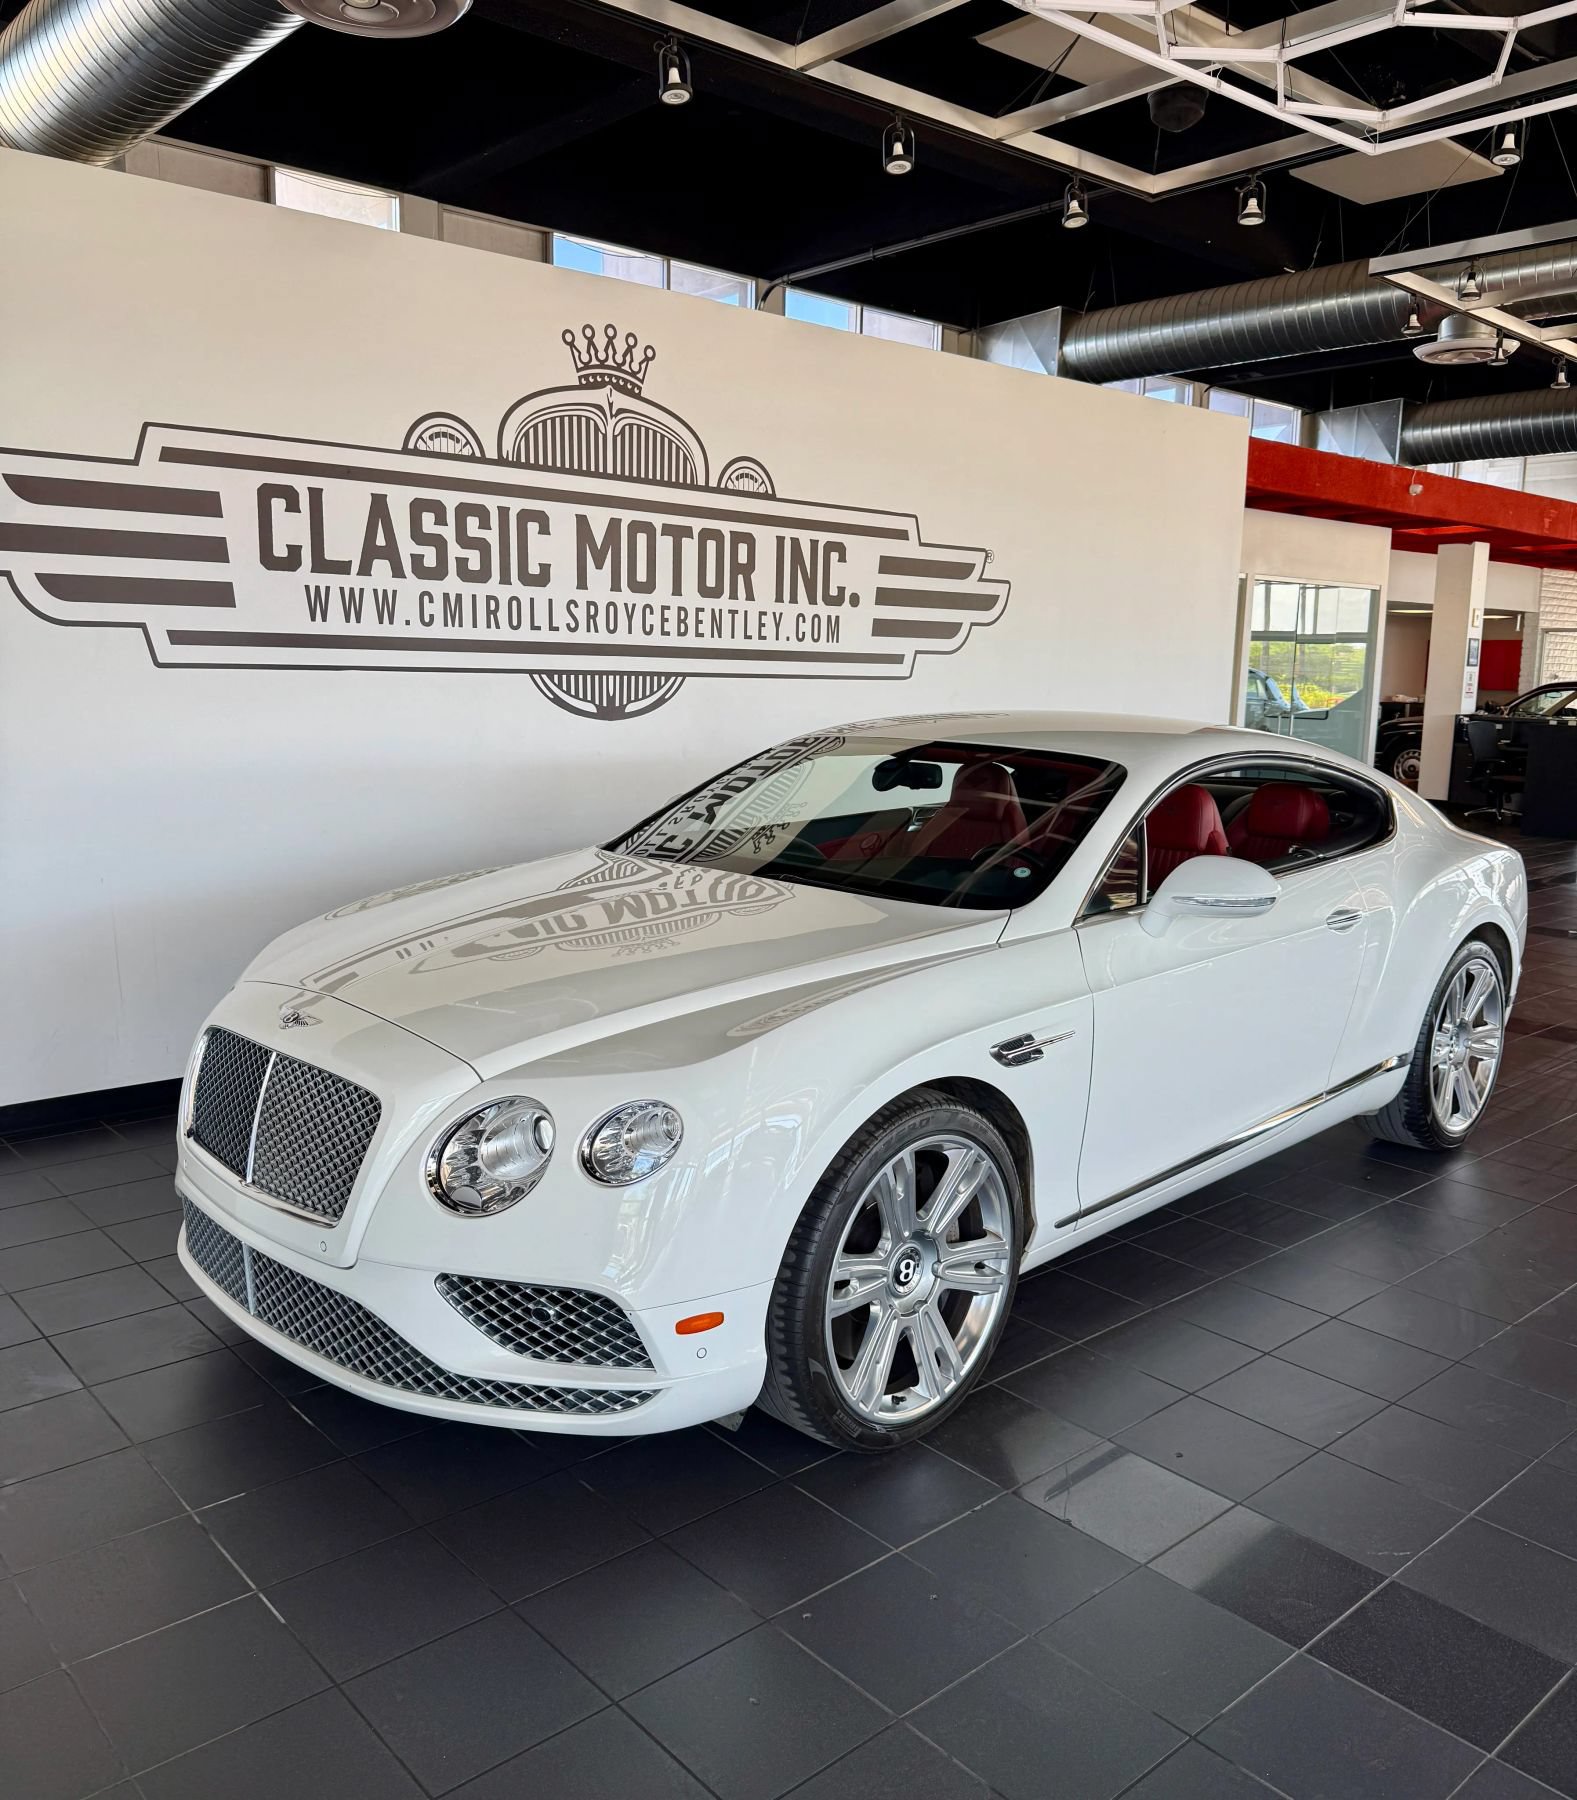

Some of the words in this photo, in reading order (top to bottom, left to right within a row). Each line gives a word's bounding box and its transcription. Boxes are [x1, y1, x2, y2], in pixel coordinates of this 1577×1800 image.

[256, 482, 552, 588] CLASSIC
[574, 513, 757, 602] MOTOR
[774, 535, 860, 608] INC.
[303, 584, 841, 644] WWW.CMIROLLSROYCEBENTLEY.COM
